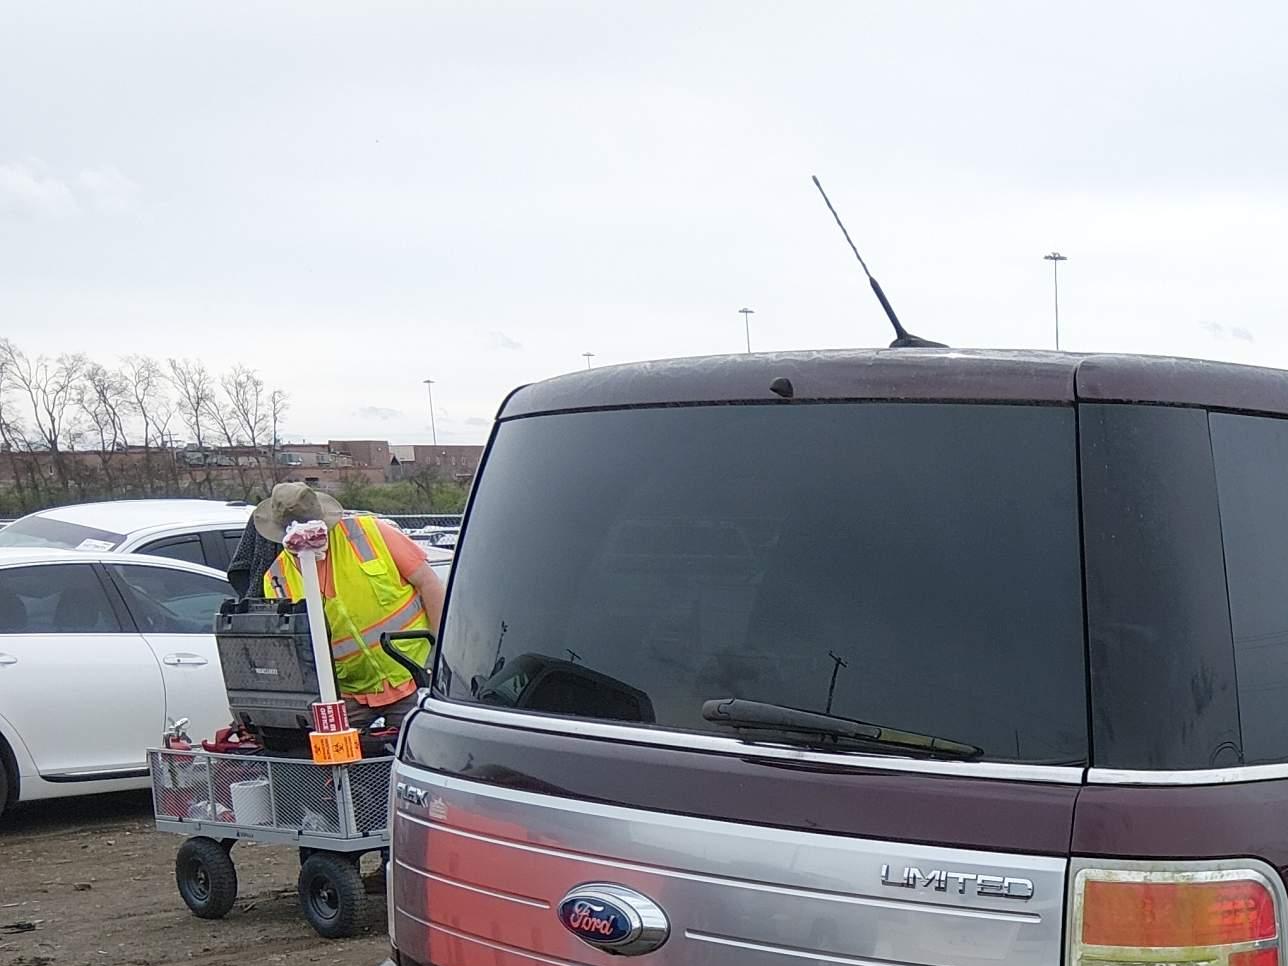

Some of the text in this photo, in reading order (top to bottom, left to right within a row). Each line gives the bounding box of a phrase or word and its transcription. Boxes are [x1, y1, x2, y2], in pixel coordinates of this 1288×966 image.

[319, 707, 330, 730] OFFICE
[396, 782, 430, 808] FLEX
[880, 863, 1034, 900] LIMITED
[570, 900, 615, 935] Ford
